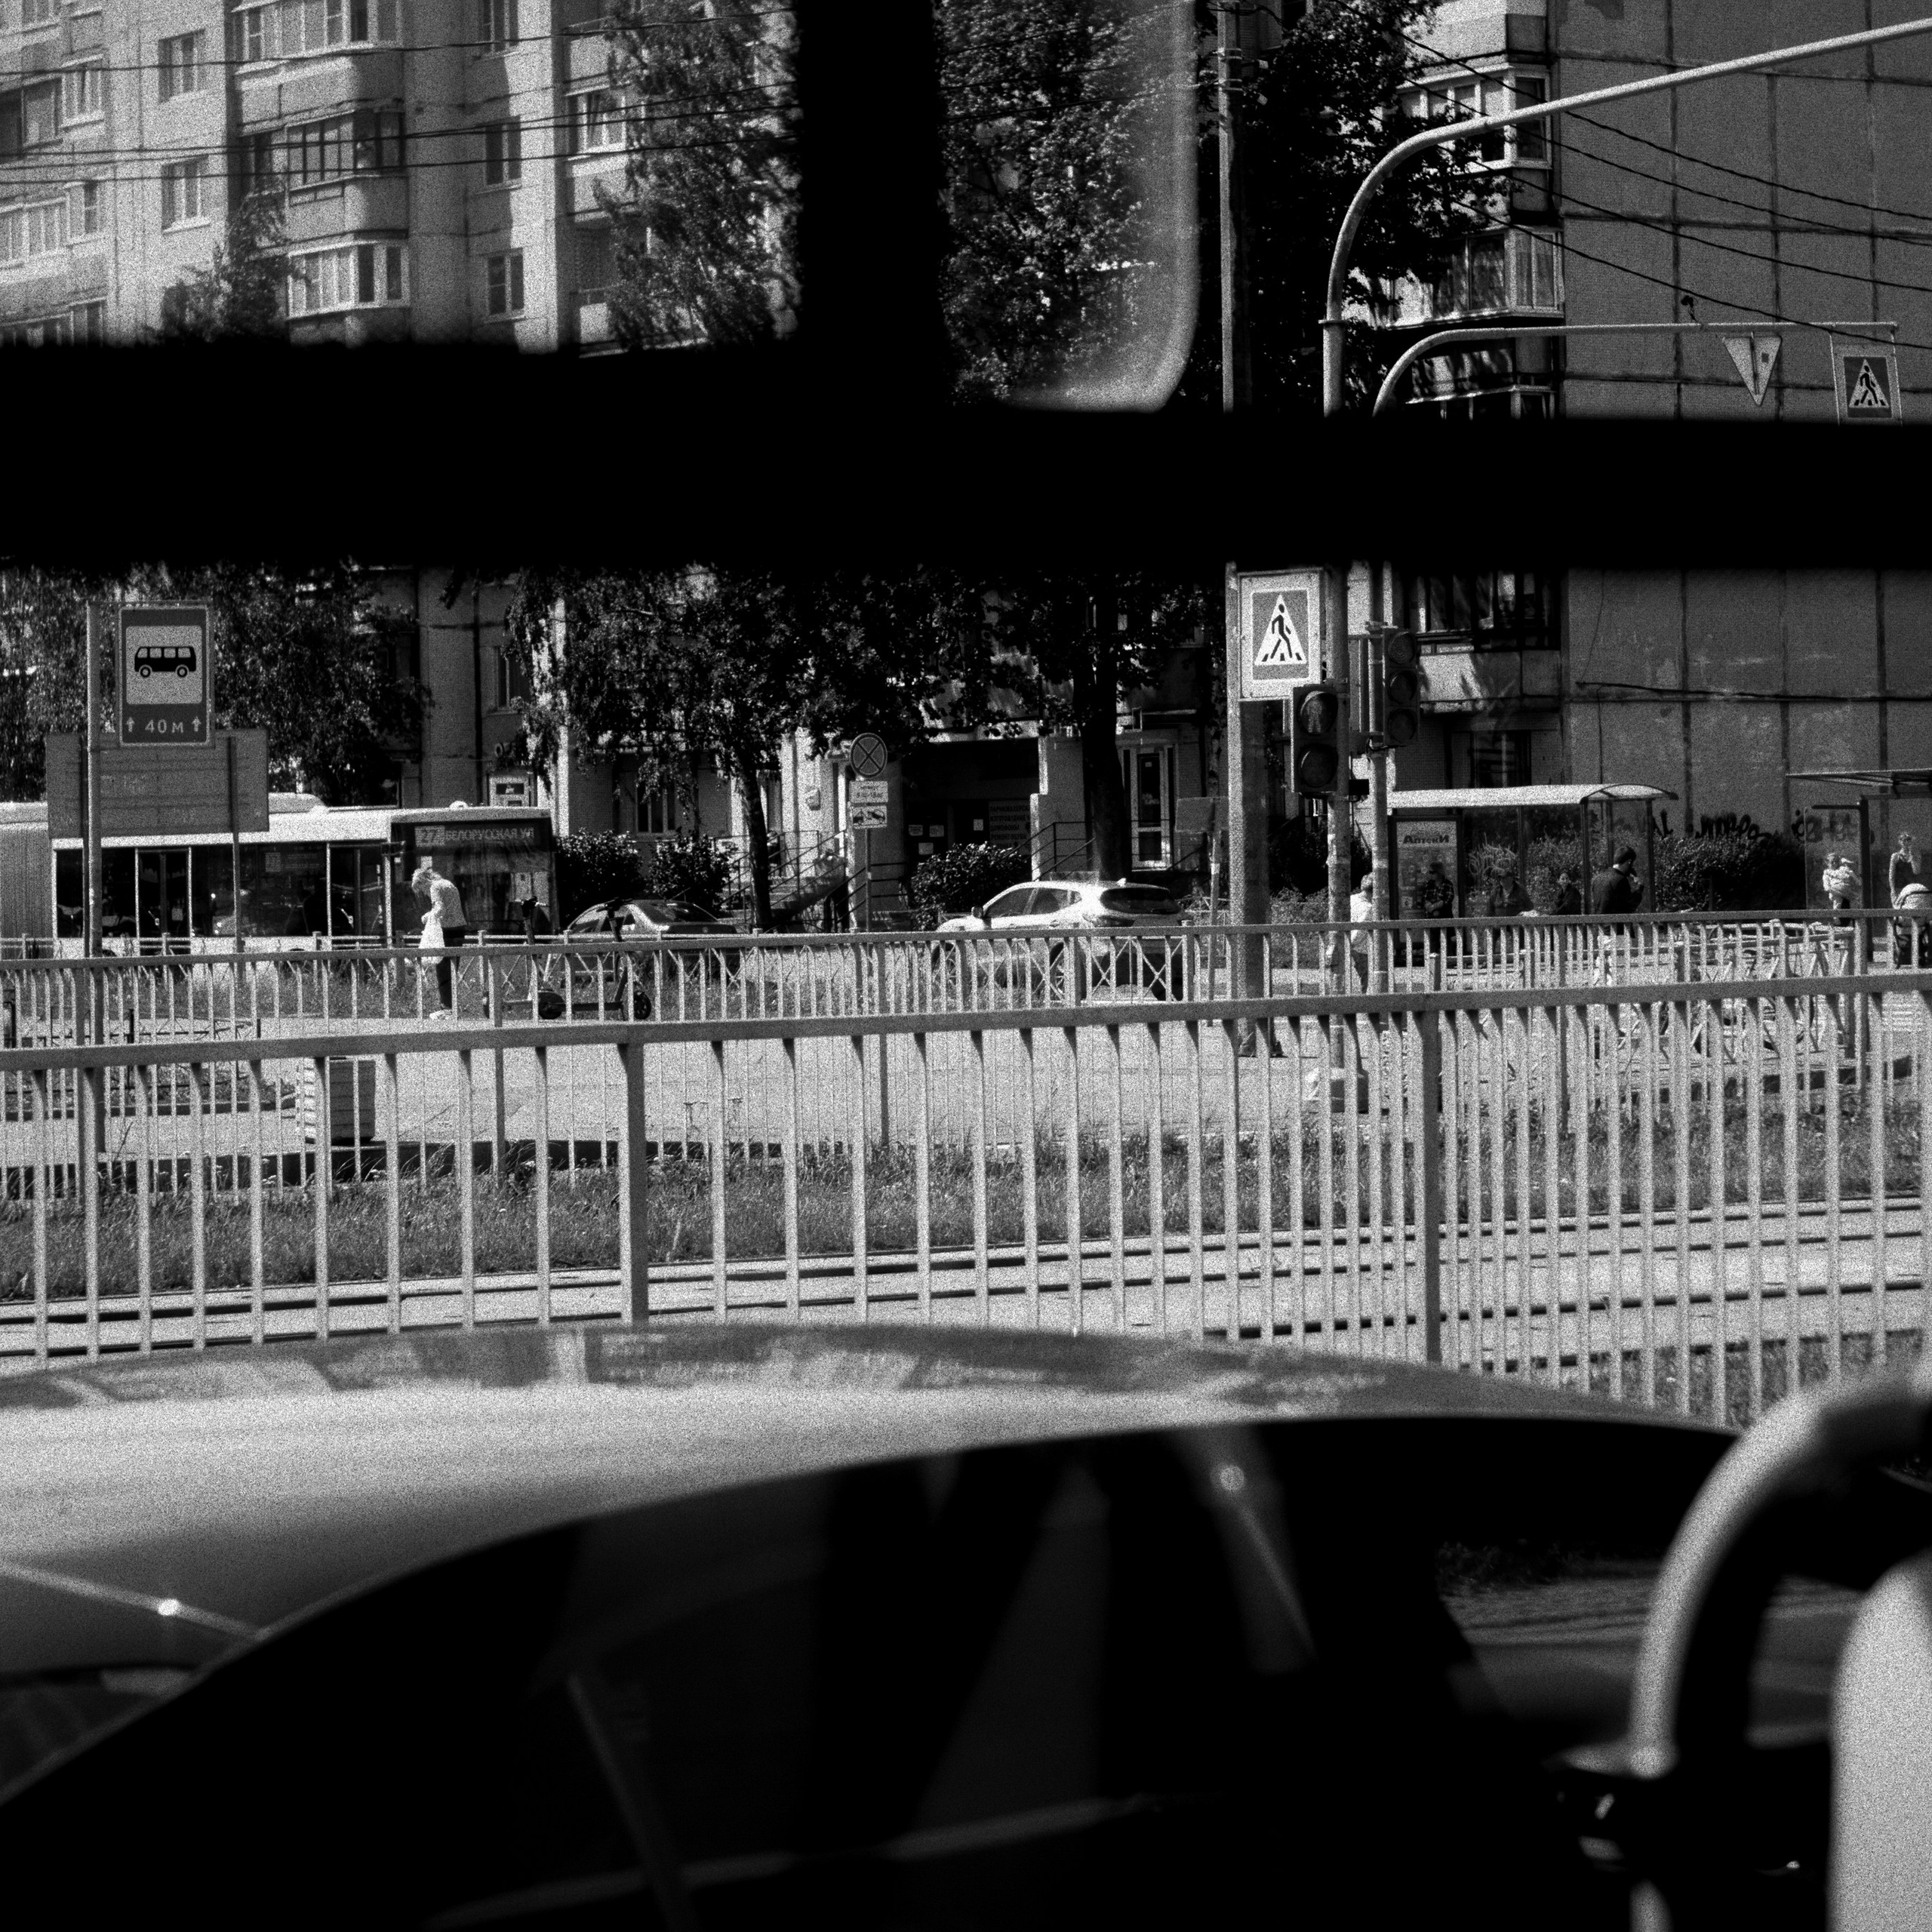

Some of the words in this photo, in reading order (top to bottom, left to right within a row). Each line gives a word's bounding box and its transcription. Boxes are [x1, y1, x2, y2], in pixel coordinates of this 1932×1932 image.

[144, 718, 168, 734] 40
[420, 828, 438, 843] 27
[445, 829, 518, 841] БЕЛОРУССКАЯ
